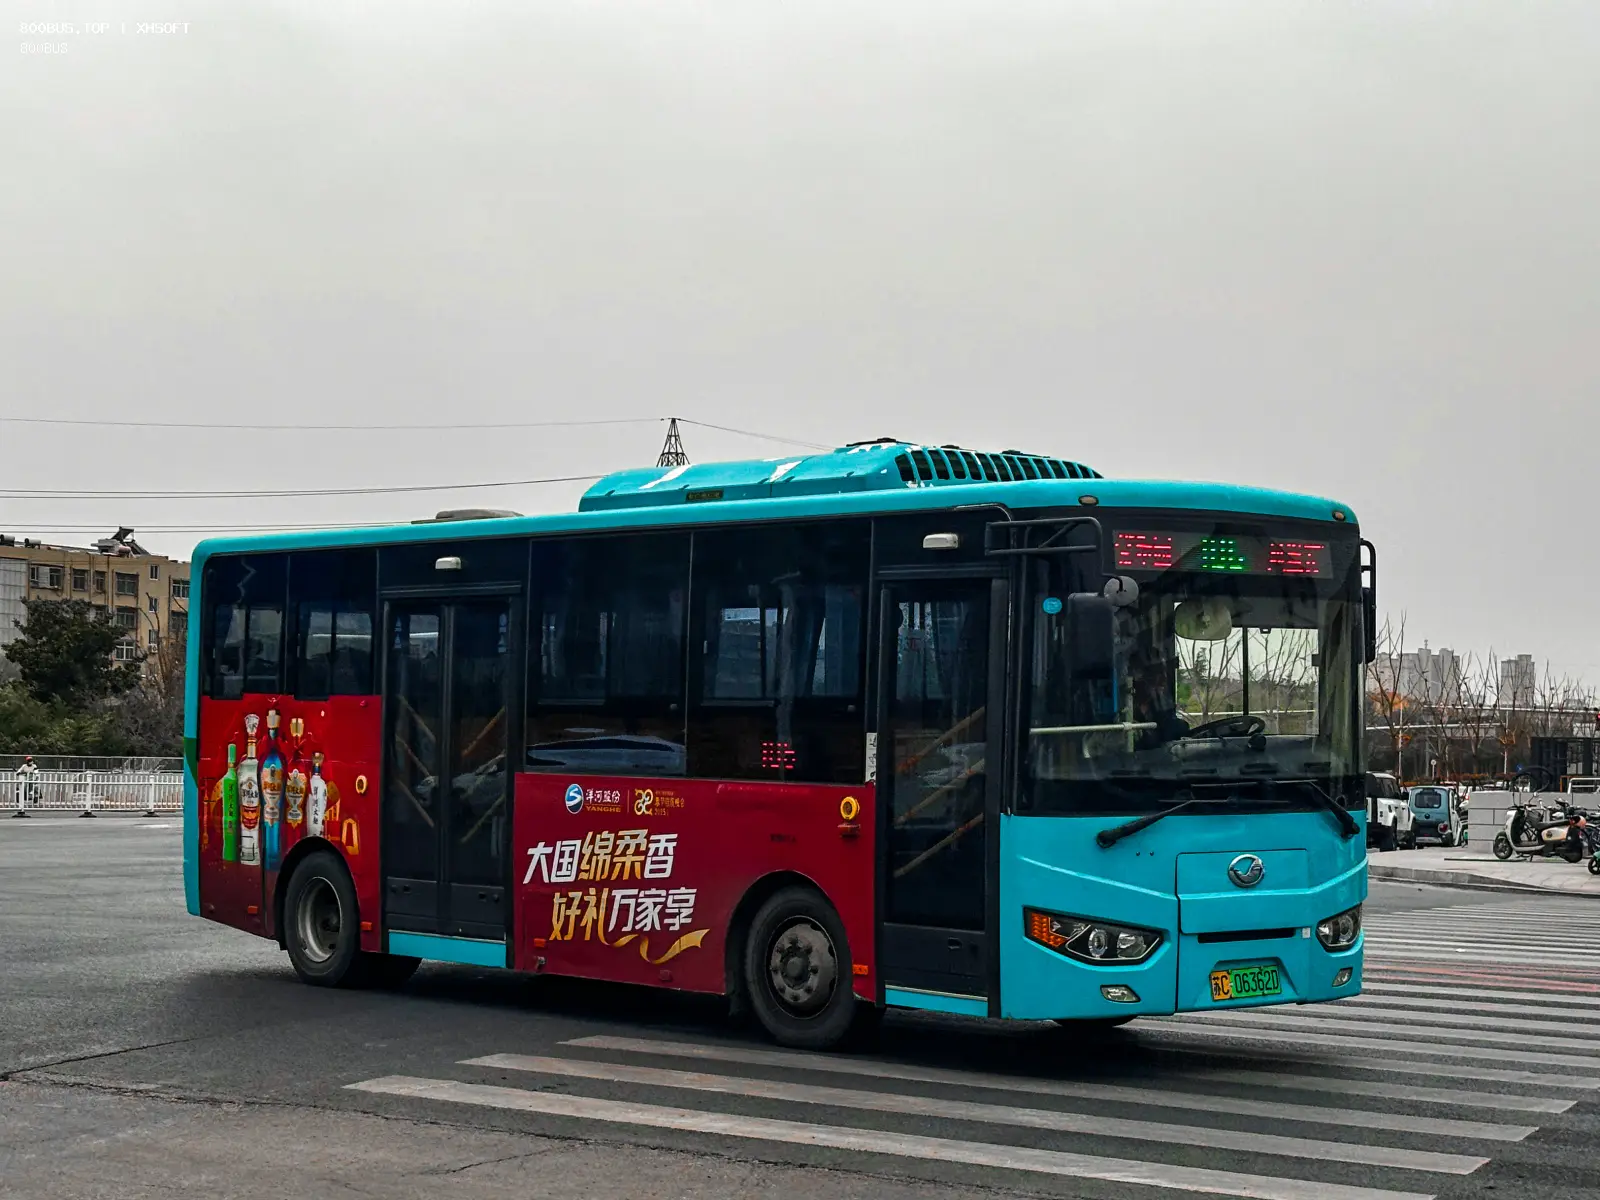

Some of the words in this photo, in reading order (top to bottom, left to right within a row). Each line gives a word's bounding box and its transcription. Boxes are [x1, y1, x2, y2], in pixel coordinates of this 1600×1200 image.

[585, 788, 620, 804] 洋河股份
[585, 805, 621, 813] YANGHE
[522, 829, 678, 884] 大国绵柔香
[549, 887, 698, 942] 好礼万家享
